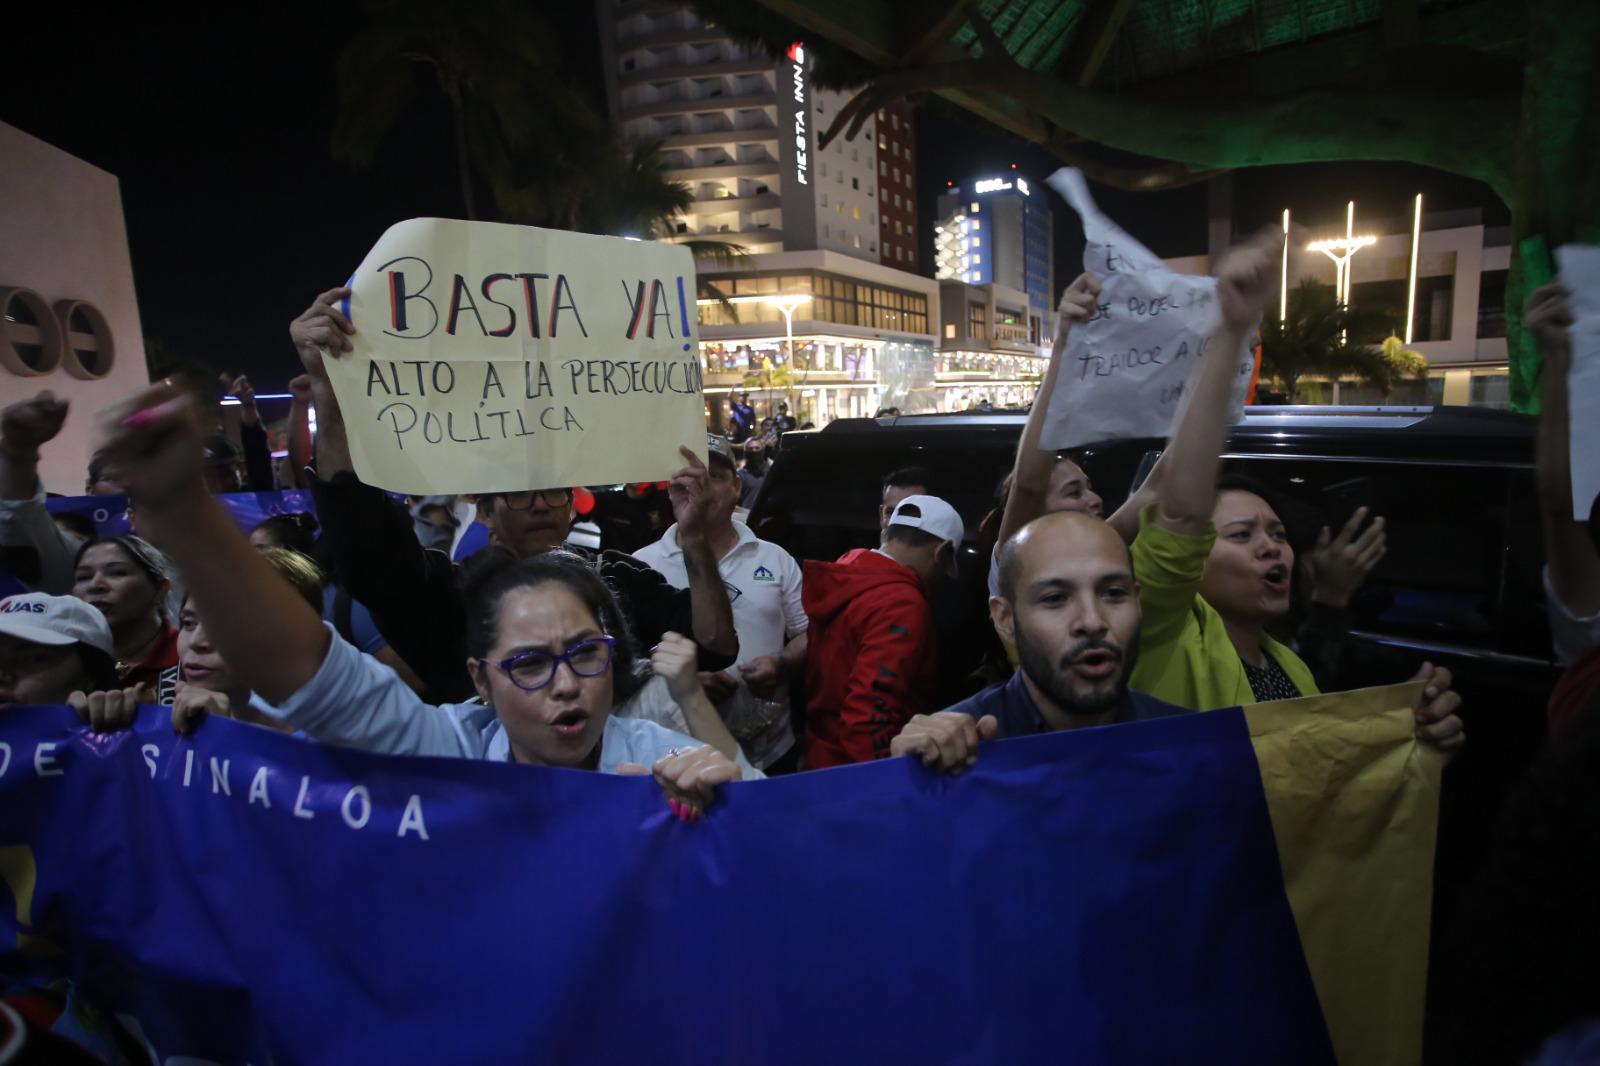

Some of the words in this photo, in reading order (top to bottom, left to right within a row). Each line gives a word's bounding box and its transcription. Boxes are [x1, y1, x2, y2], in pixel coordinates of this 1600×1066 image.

[792, 64, 805, 103] INN
[795, 111, 808, 185] FIESTA
[377, 256, 588, 340] BASTA
[621, 275, 692, 352] YA!
[1175, 341, 1189, 361] A
[367, 361, 455, 398] ALTO
[483, 362, 505, 400] A
[525, 361, 554, 400] LA
[377, 401, 584, 450] POLÍTICA
[141, 743, 430, 841] SINALOA
